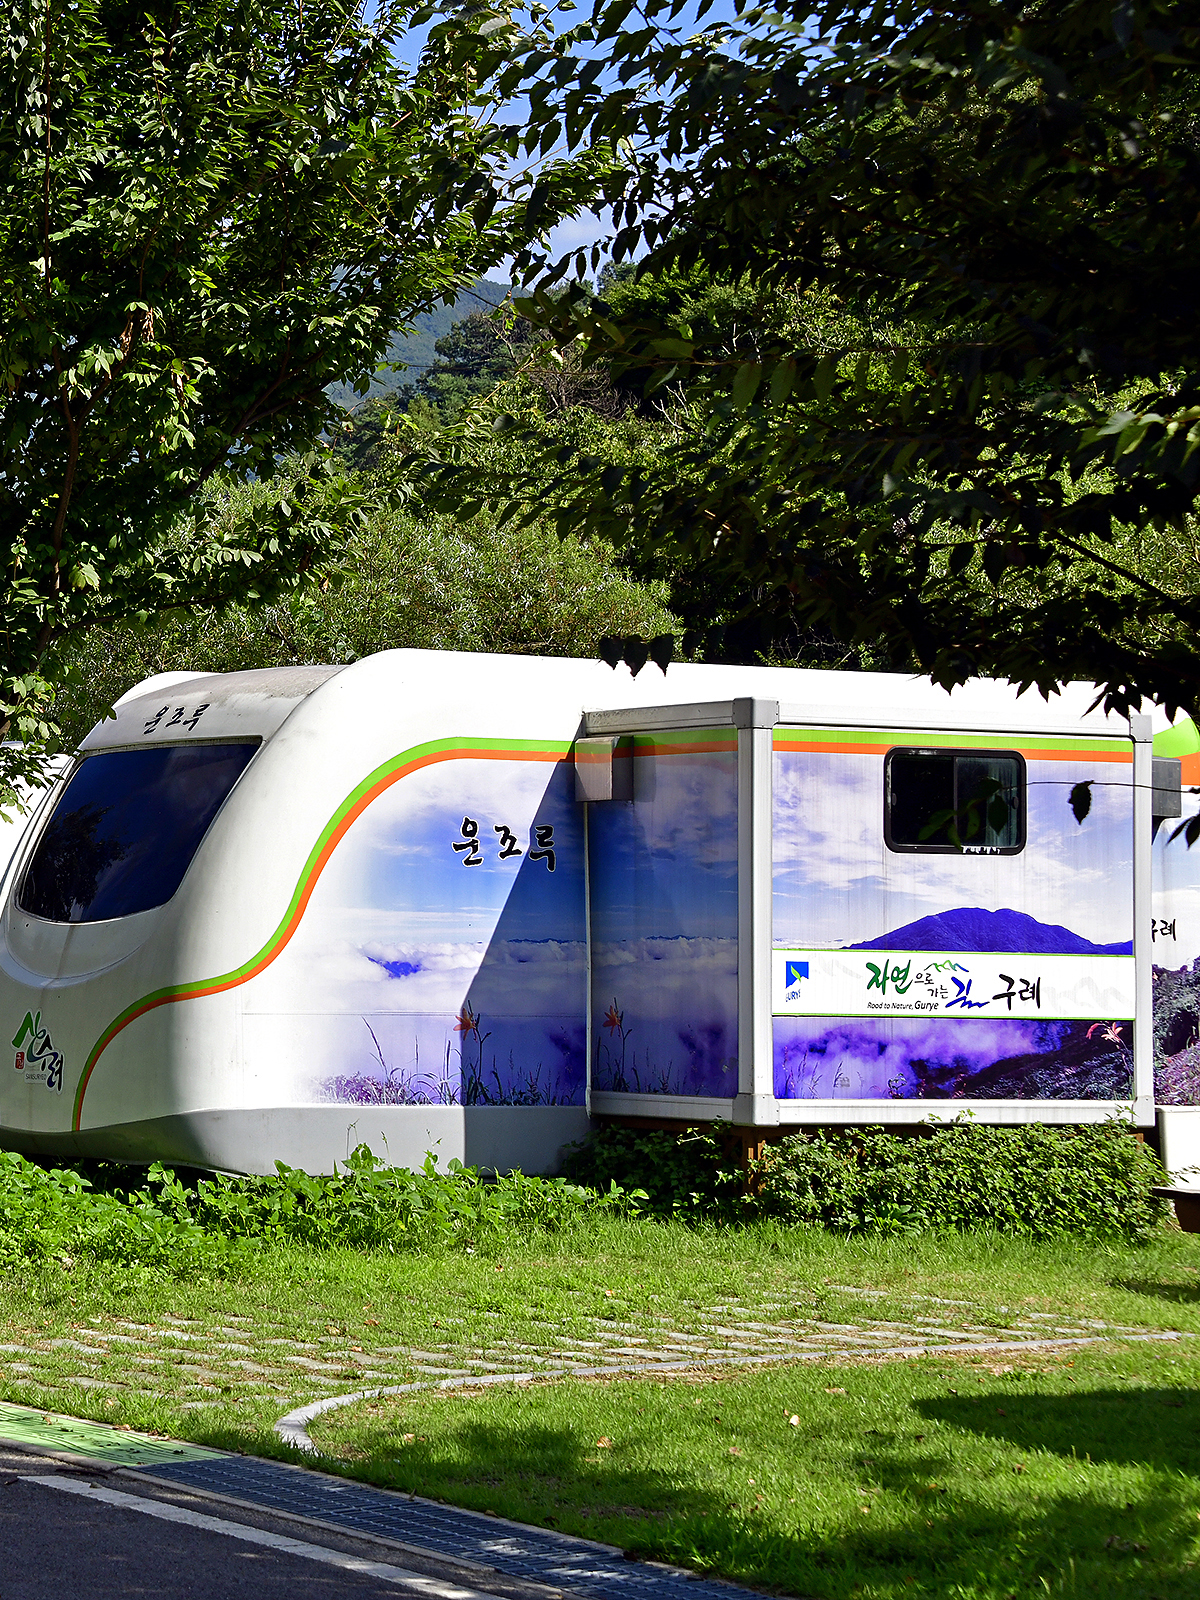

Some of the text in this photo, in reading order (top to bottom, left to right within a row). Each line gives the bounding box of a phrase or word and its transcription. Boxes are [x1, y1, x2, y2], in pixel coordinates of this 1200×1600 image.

[143, 703, 211, 735] 운조루
[452, 816, 555, 872] 운조루
[867, 1001, 884, 1010] Road
[884, 1002, 891, 1010] to
[914, 1000, 939, 1012] Gurye
[927, 984, 949, 1000] 가는
[992, 973, 1041, 1011] 구례
